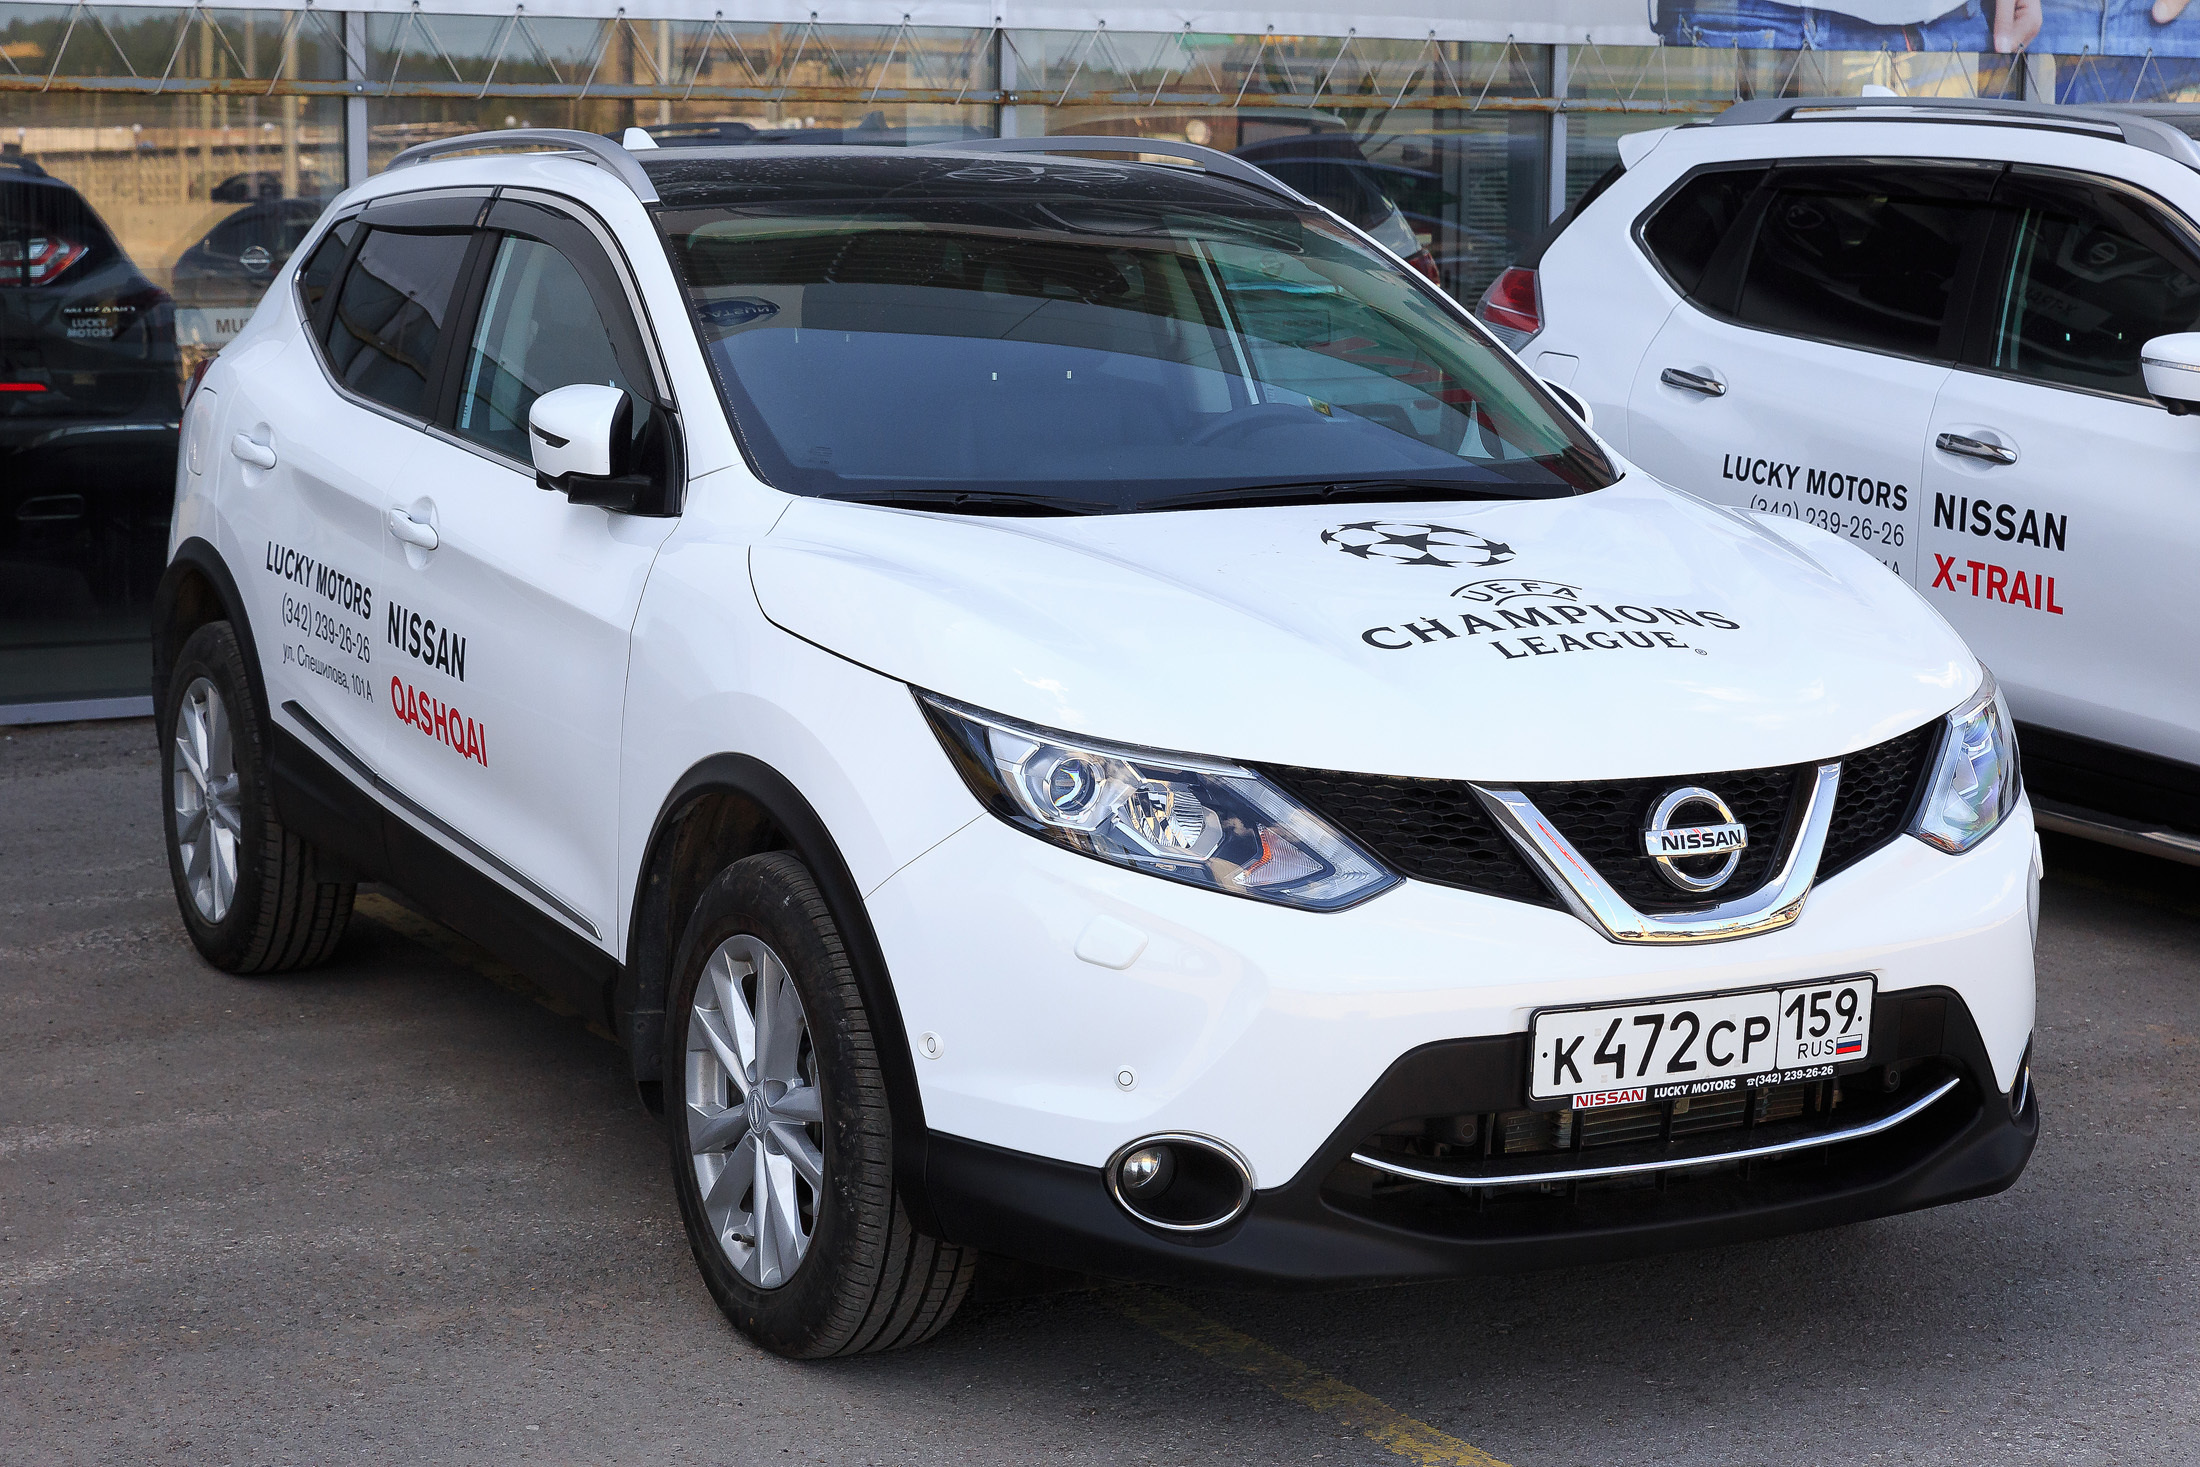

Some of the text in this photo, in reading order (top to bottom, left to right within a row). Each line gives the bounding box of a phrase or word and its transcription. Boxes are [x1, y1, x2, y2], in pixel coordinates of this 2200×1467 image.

[1722, 453, 1908, 511] LUCKY MOTORS
[1806, 507, 1904, 547] 239-26-26
[1933, 491, 2068, 552] NISSAN
[266, 540, 372, 620] LUCKY MOTORS
[1461, 582, 1578, 602] UEFA
[1931, 552, 2064, 616] X-TRAIL
[282, 591, 370, 664] (342) 239-26-26
[387, 600, 467, 682] NISSAN
[1361, 604, 1741, 650] CHAMPIONS
[1488, 631, 1690, 660] LEAGUE
[283, 643, 295, 664] ул.
[297, 644, 350, 694] Спешилова,
[391, 675, 489, 769] QASHQAI
[1661, 829, 1742, 851] NISSAN
[1785, 987, 1859, 1041] 159
[1797, 1039, 1834, 1060] RUS
[1575, 1088, 1645, 1108] NISSAN
[1654, 1083, 1689, 1099] LUCKY
[1691, 1078, 1737, 1094] MOTORS
[1784, 1065, 1834, 1082] 239-26-26
